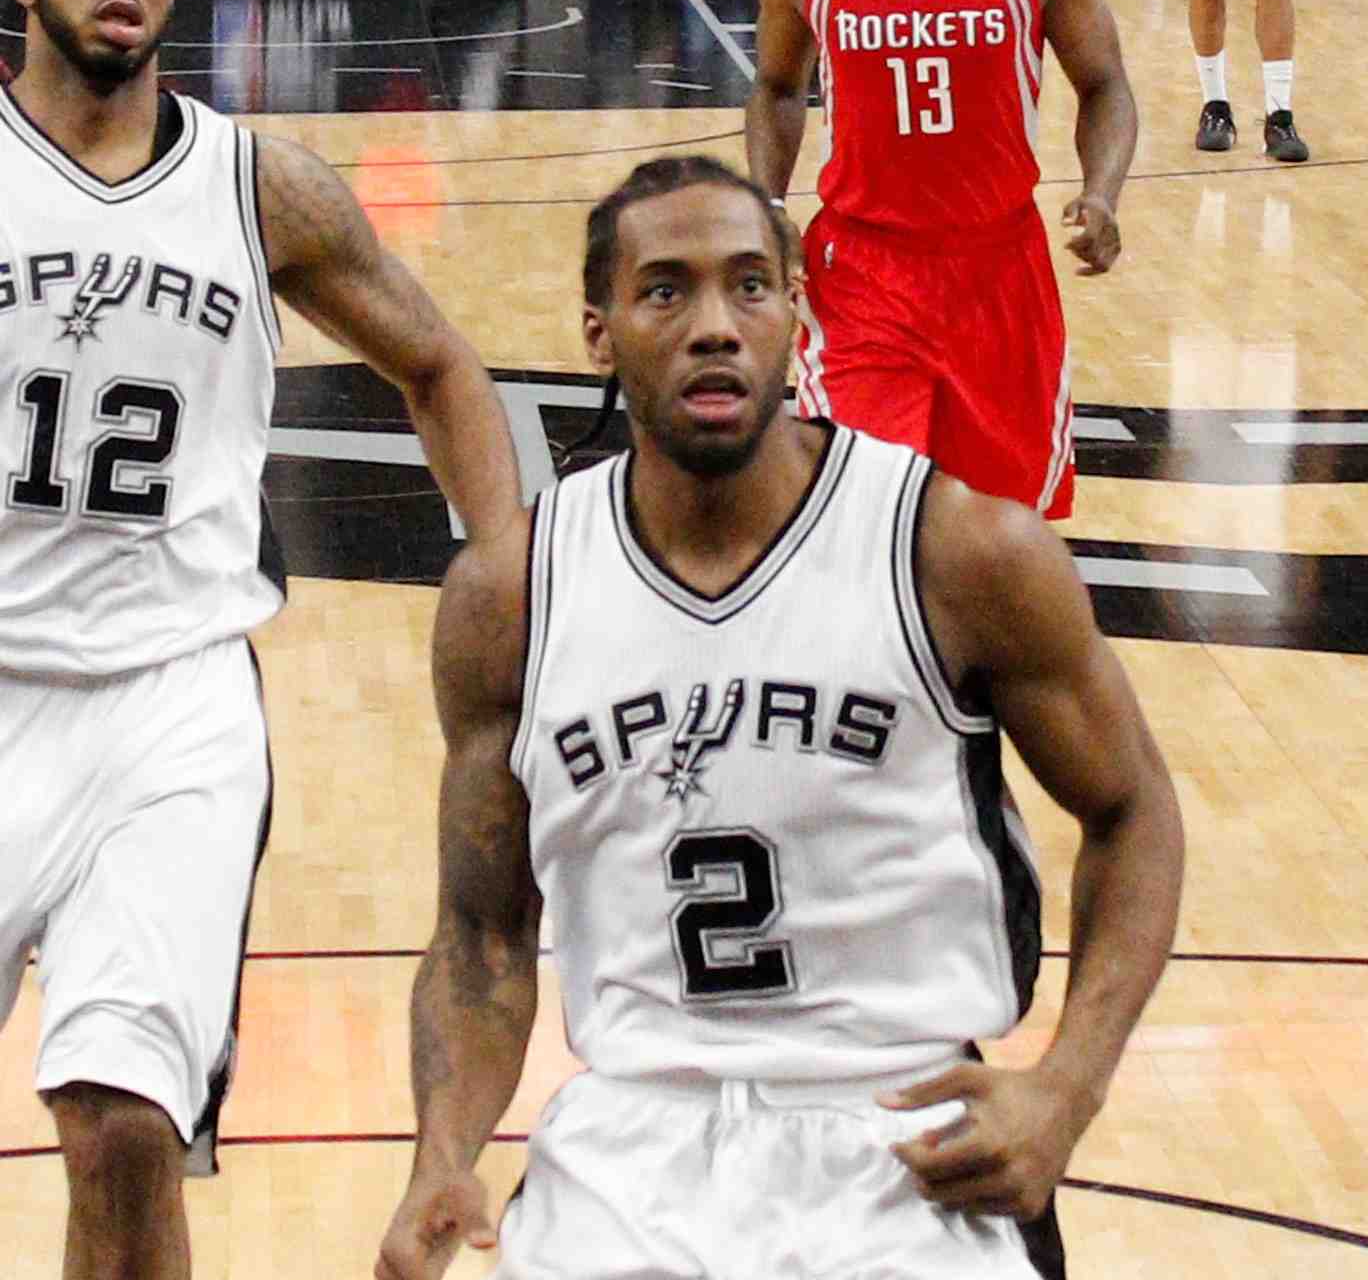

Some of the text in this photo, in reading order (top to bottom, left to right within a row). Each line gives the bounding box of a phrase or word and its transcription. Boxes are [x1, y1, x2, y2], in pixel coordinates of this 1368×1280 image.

[834, 8, 1006, 52] ROCKETS
[885, 56, 955, 136] 13
[6, 368, 187, 522] 12
[554, 677, 898, 800] SPURS
[662, 824, 799, 1004] 2
